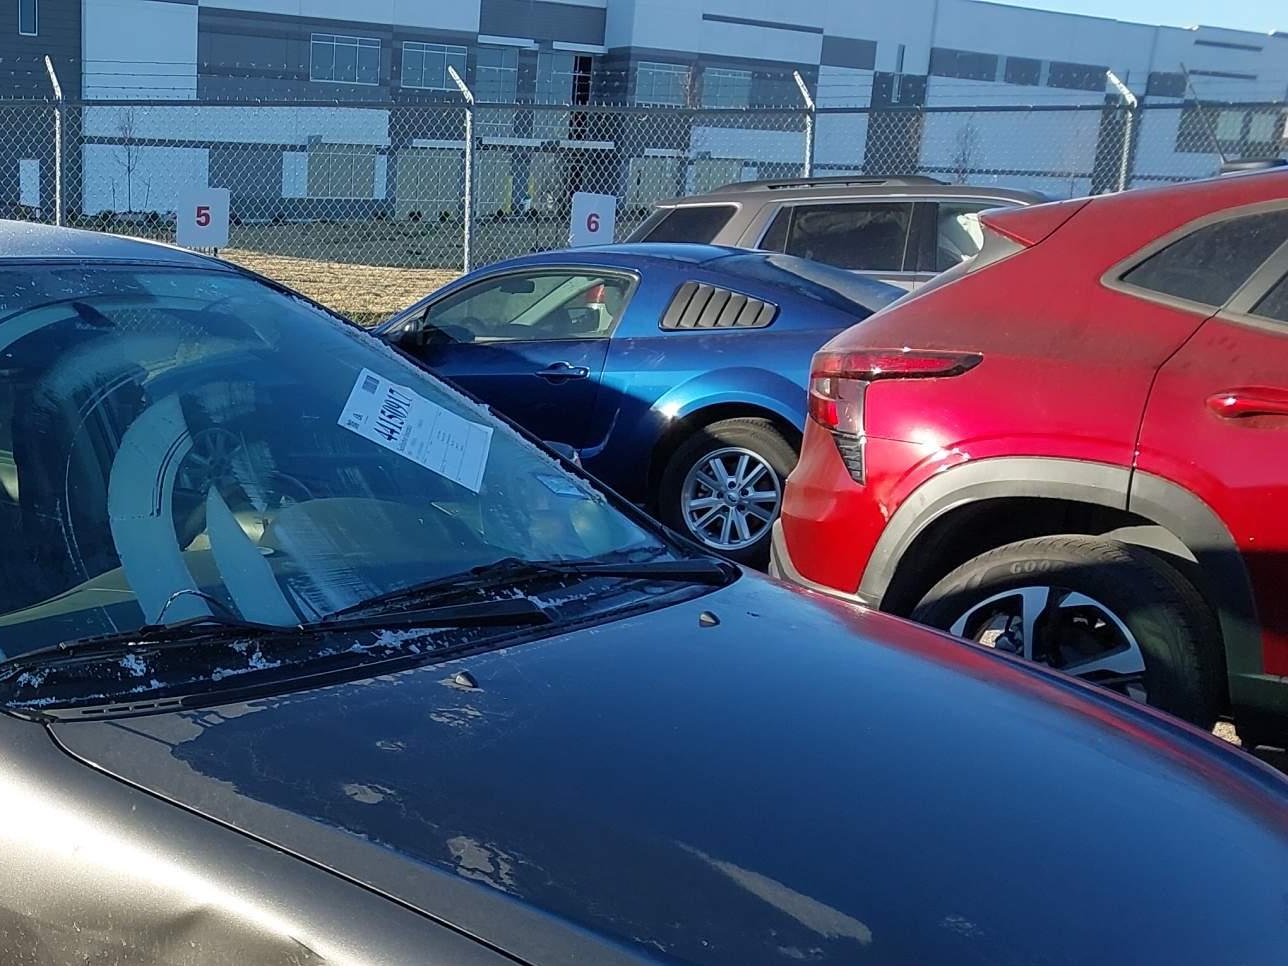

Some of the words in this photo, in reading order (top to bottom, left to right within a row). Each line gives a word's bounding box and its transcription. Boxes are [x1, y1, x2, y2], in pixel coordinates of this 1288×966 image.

[195, 205, 211, 228] 5
[586, 212, 601, 234] 6
[372, 386, 414, 442] 44150917
